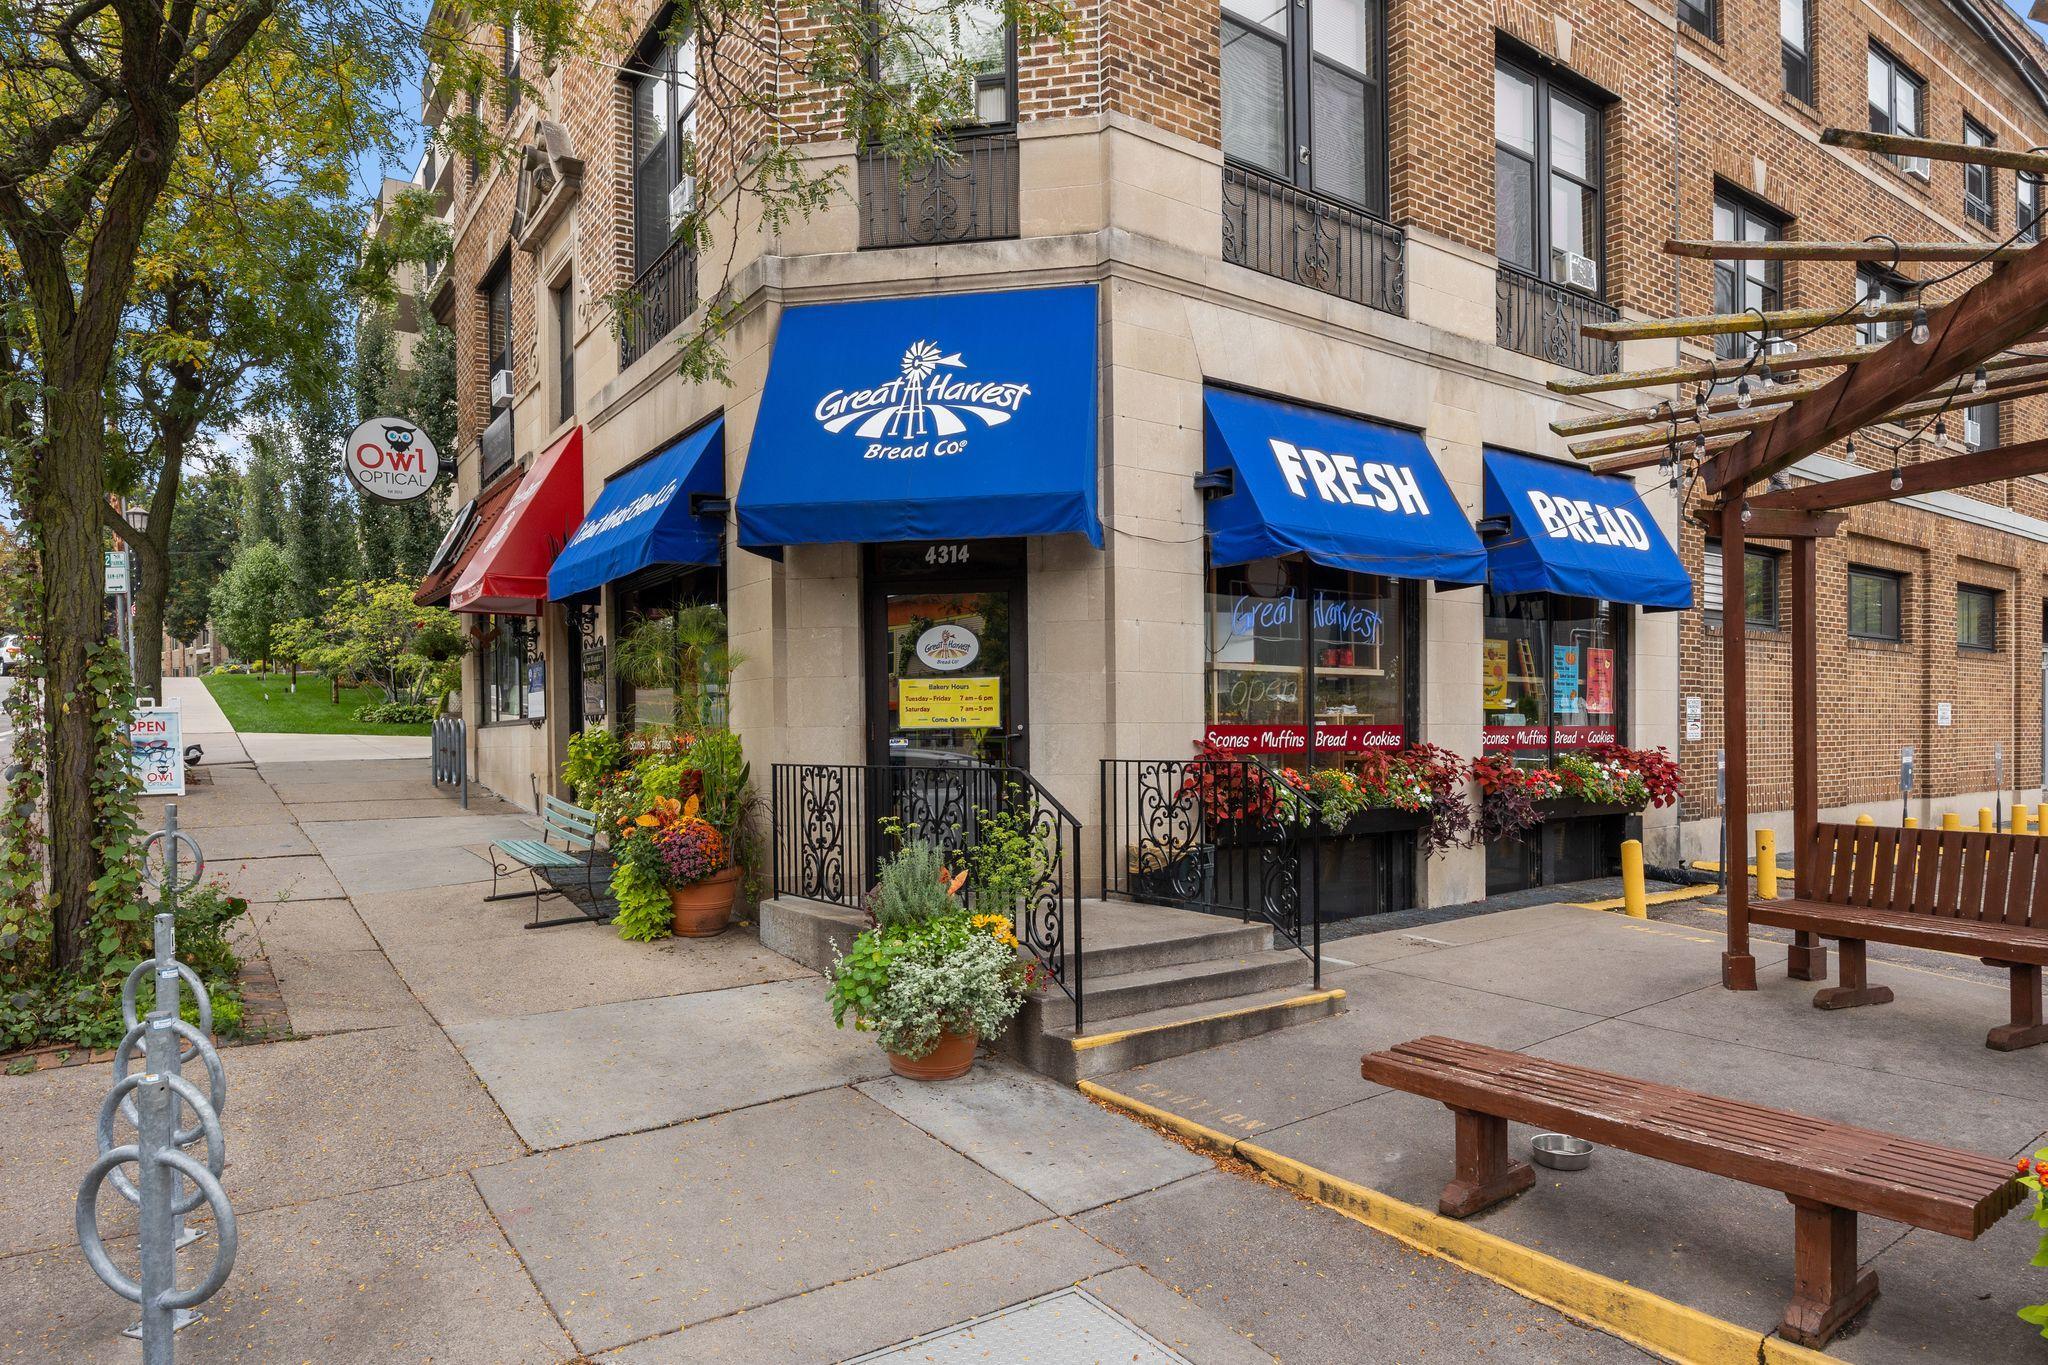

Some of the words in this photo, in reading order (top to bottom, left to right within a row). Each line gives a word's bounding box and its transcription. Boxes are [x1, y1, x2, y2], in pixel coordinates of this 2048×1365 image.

[814, 376, 905, 421] Great
[926, 373, 1032, 411] Harvest
[356, 443, 427, 473] Owl
[863, 442, 929, 460] Bread
[359, 469, 427, 487] OPTICAL
[1269, 438, 1430, 517] FRESH
[1527, 490, 1650, 551] BREAD
[104, 555, 111, 566] 2
[925, 544, 970, 565] 4314
[1232, 587, 1296, 636] Great
[1313, 591, 1383, 645] Harvest
[924, 641, 944, 653] Great
[949, 640, 971, 652] Harvest
[933, 694, 951, 702] Friday
[1230, 679, 1297, 720] open
[130, 721, 166, 733] OPEN
[1208, 731, 1250, 748] Scones
[1260, 730, 1305, 748] Muffins
[1314, 730, 1349, 747] Bread
[1362, 731, 1402, 747] Cookies
[1482, 731, 1510, 745] Scones
[1516, 729, 1548, 745] Muffins
[1554, 730, 1578, 745] Bread
[1587, 731, 1615, 744] Cookies
[147, 772, 174, 782] Owl
